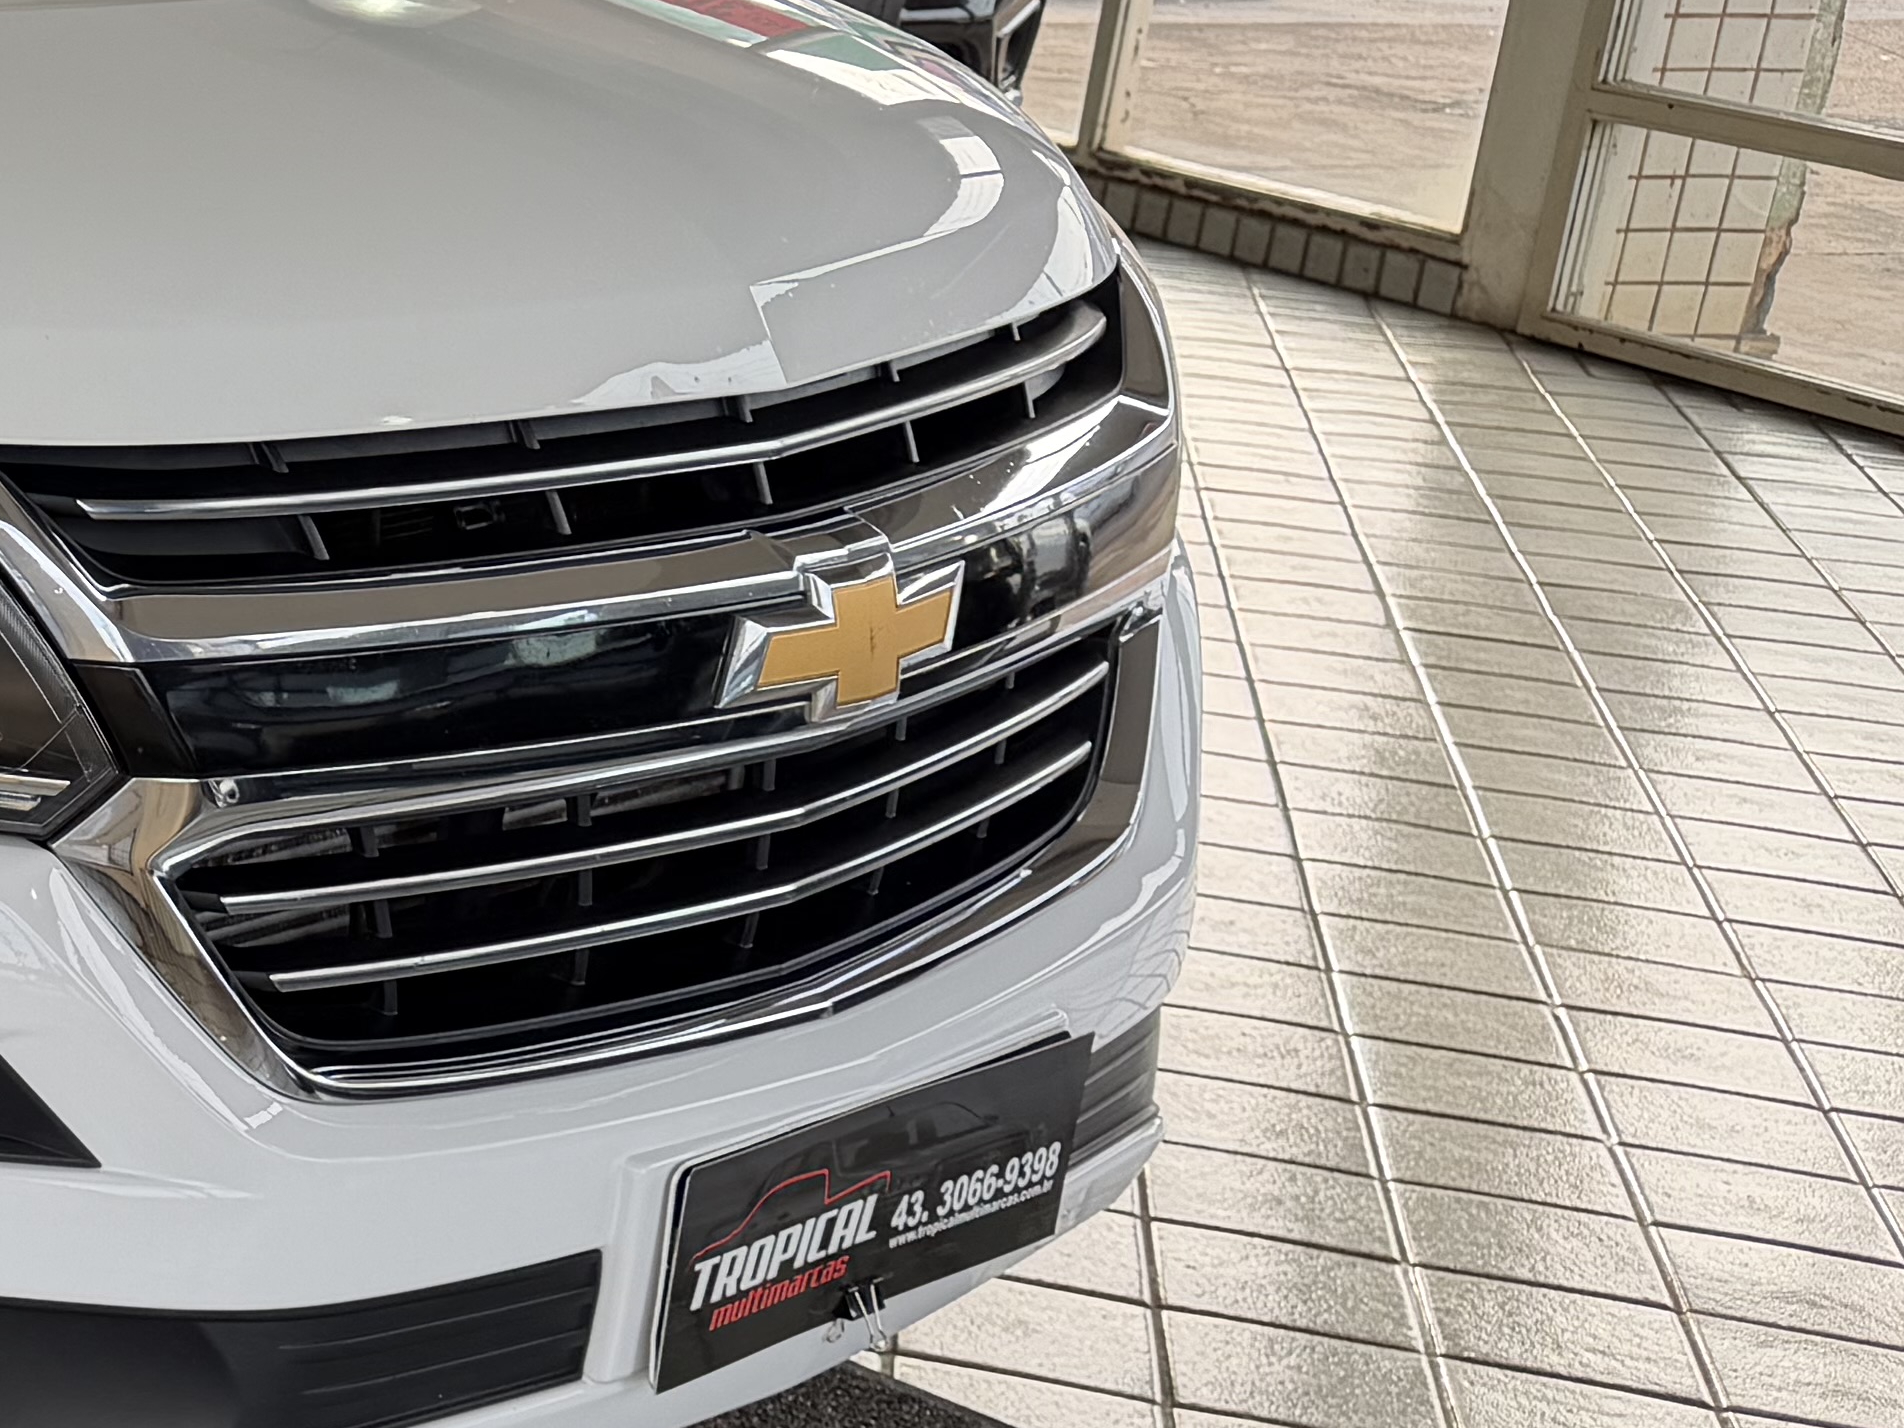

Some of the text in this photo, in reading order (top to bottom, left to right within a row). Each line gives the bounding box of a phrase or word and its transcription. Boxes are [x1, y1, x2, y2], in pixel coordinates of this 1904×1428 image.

[890, 1140, 1062, 1232] 43. 3066-9398
[690, 1192, 879, 1312] TROPICAL
[708, 1254, 850, 1332] multimarcas
